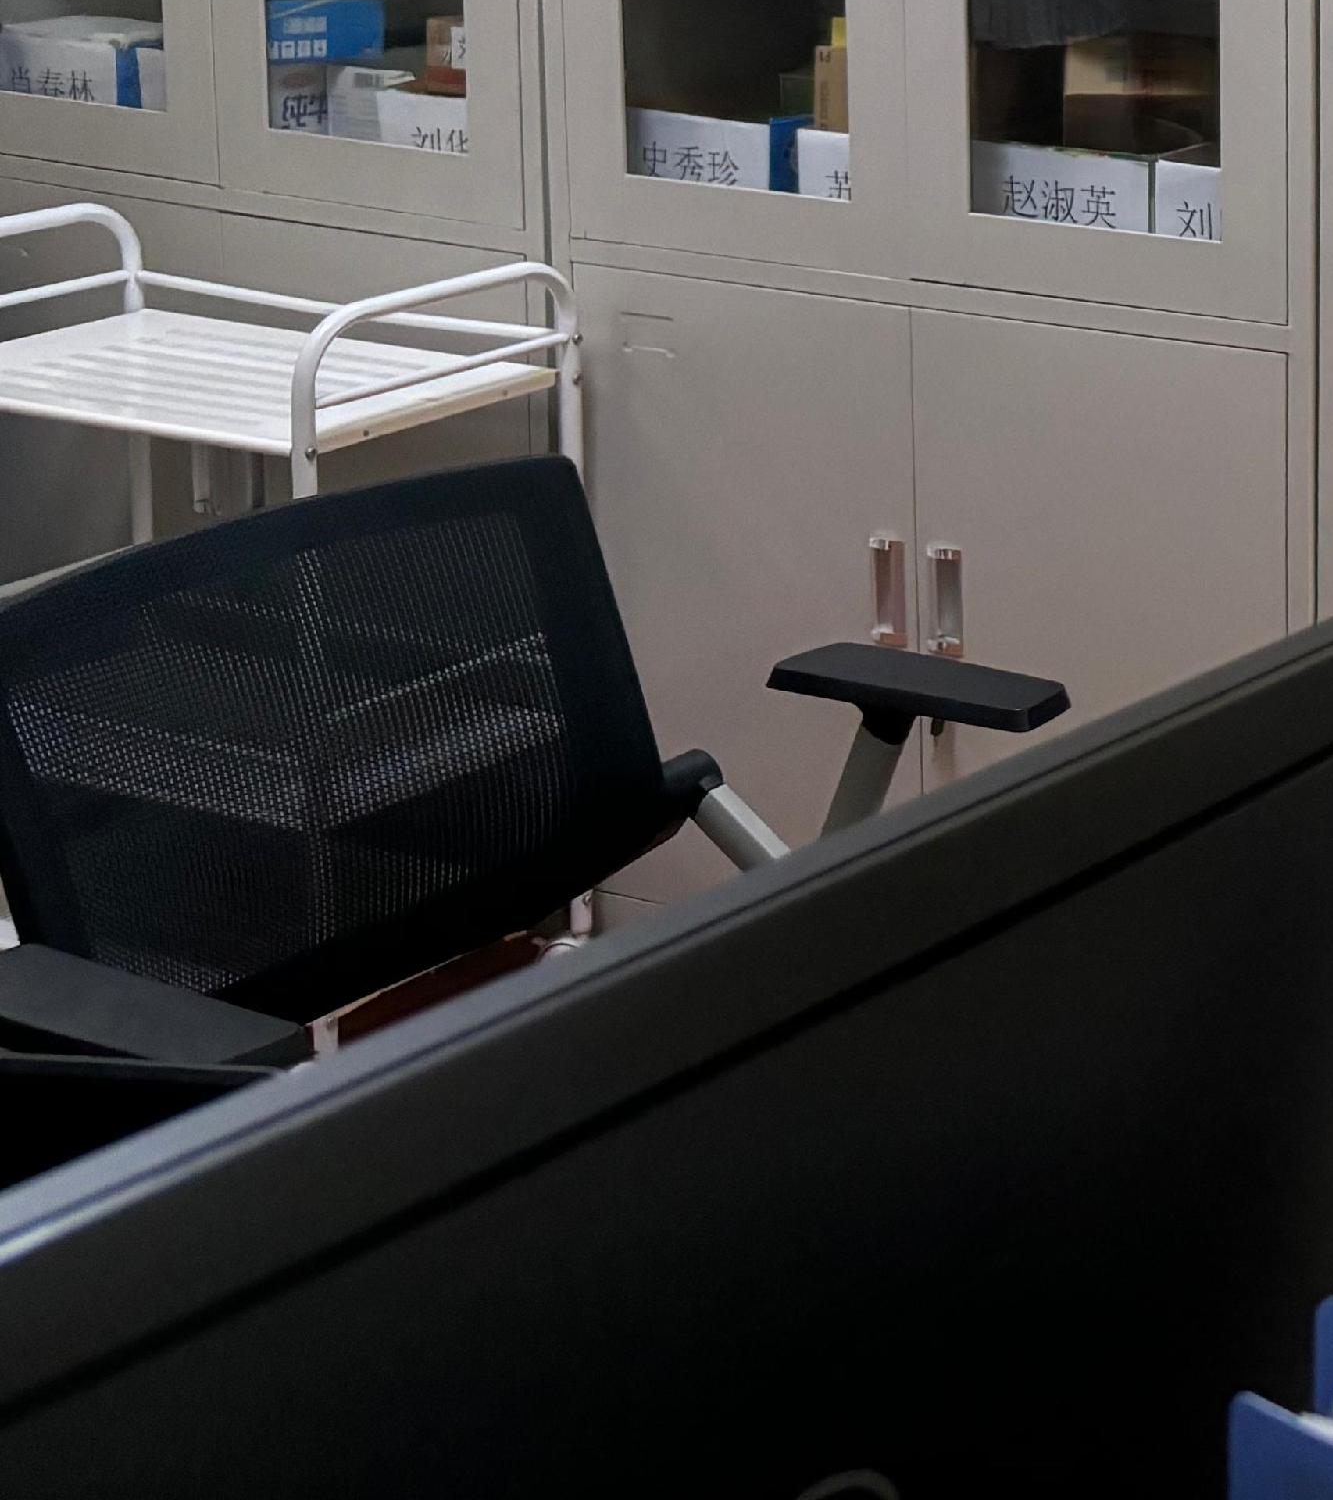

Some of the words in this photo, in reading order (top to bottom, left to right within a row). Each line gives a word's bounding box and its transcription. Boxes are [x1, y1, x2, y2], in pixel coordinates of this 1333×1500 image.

[642, 141, 739, 186] 史秀珍
[1002, 175, 1116, 228] 赵淑英
[1177, 201, 1213, 240] 刘
